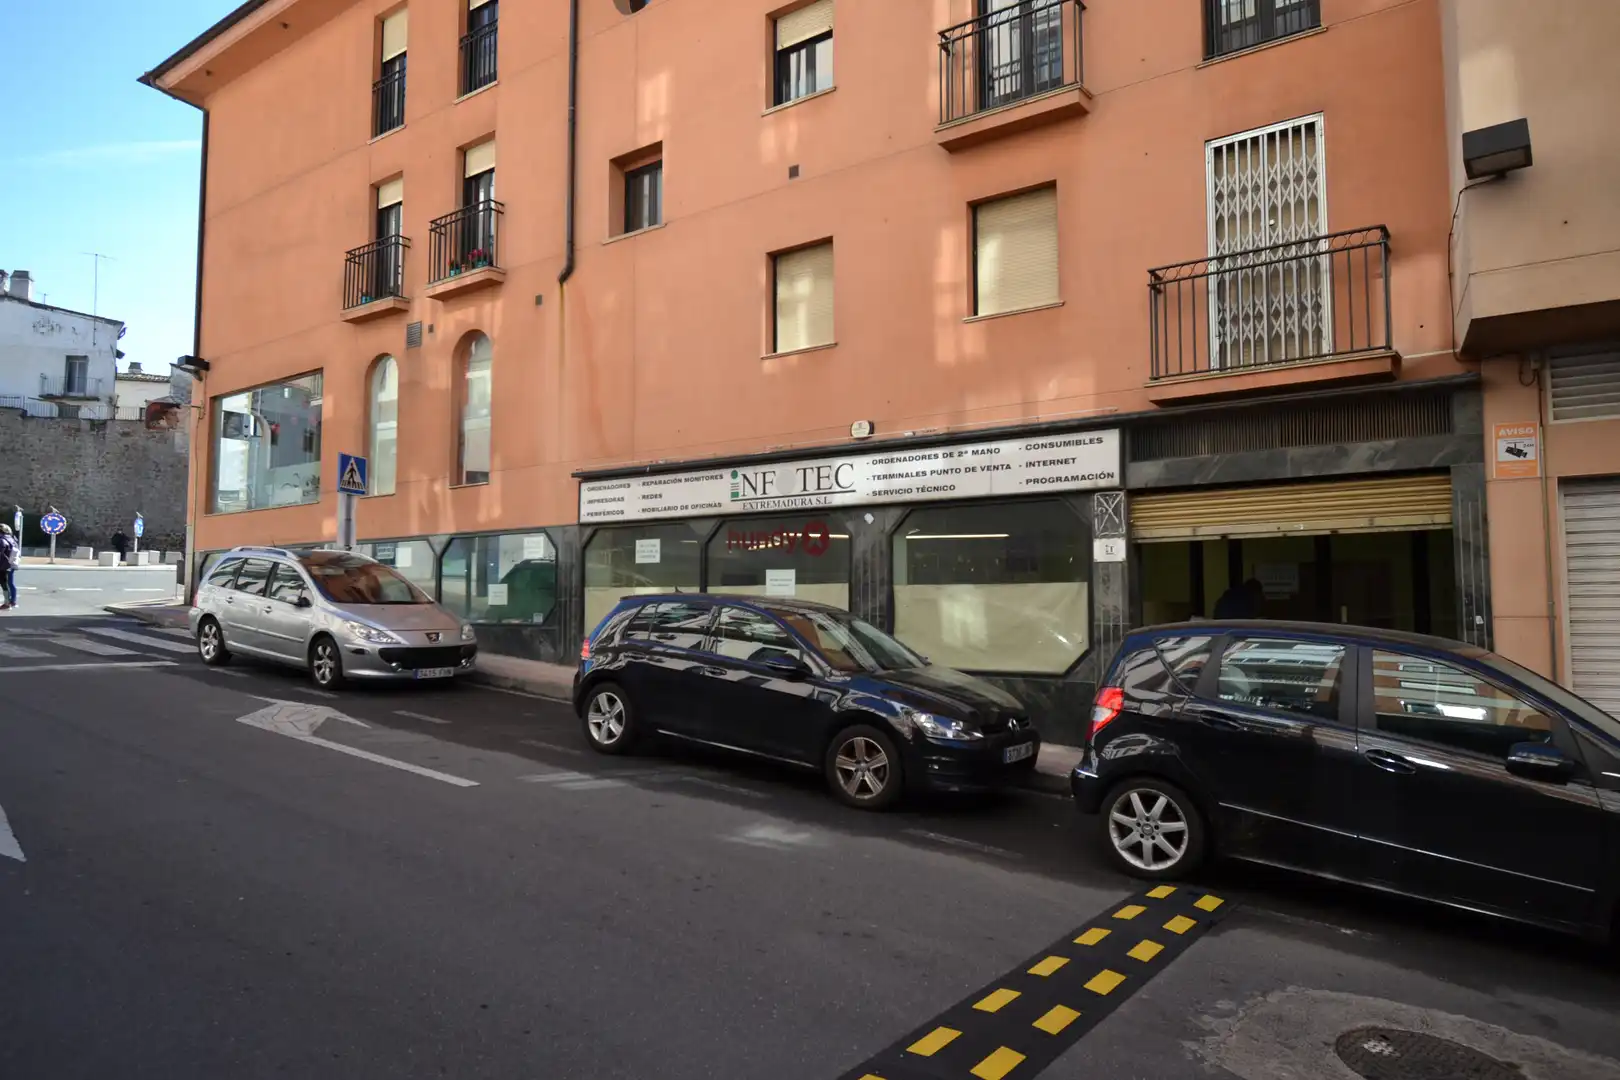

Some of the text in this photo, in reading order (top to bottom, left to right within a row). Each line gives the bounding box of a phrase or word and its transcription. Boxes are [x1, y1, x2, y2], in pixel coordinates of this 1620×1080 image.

[1499, 427, 1534, 436] AVISO
[1025, 437, 1104, 451] CONSUMIBLES
[872, 453, 939, 465] ORDENADORES
[971, 448, 1001, 456] MANO
[1025, 458, 1077, 468] INTERNET
[872, 470, 928, 481] TERMINALES
[930, 467, 962, 476] PUNTO
[980, 464, 1012, 472] VENTA
[1025, 470, 1115, 485] PROGRAMACIÓN
[586, 482, 631, 492] ORDENADORES
[641, 474, 724, 487] REPARACIÓN MONITORES
[872, 484, 956, 497] SERVICIO TÉCNICO
[586, 496, 625, 504] IMPRESORAS
[742, 496, 832, 510] EXTREMADURA S.L.
[586, 508, 625, 517] PERIFÉRICOS
[641, 505, 678, 513] MOBILIARIO
